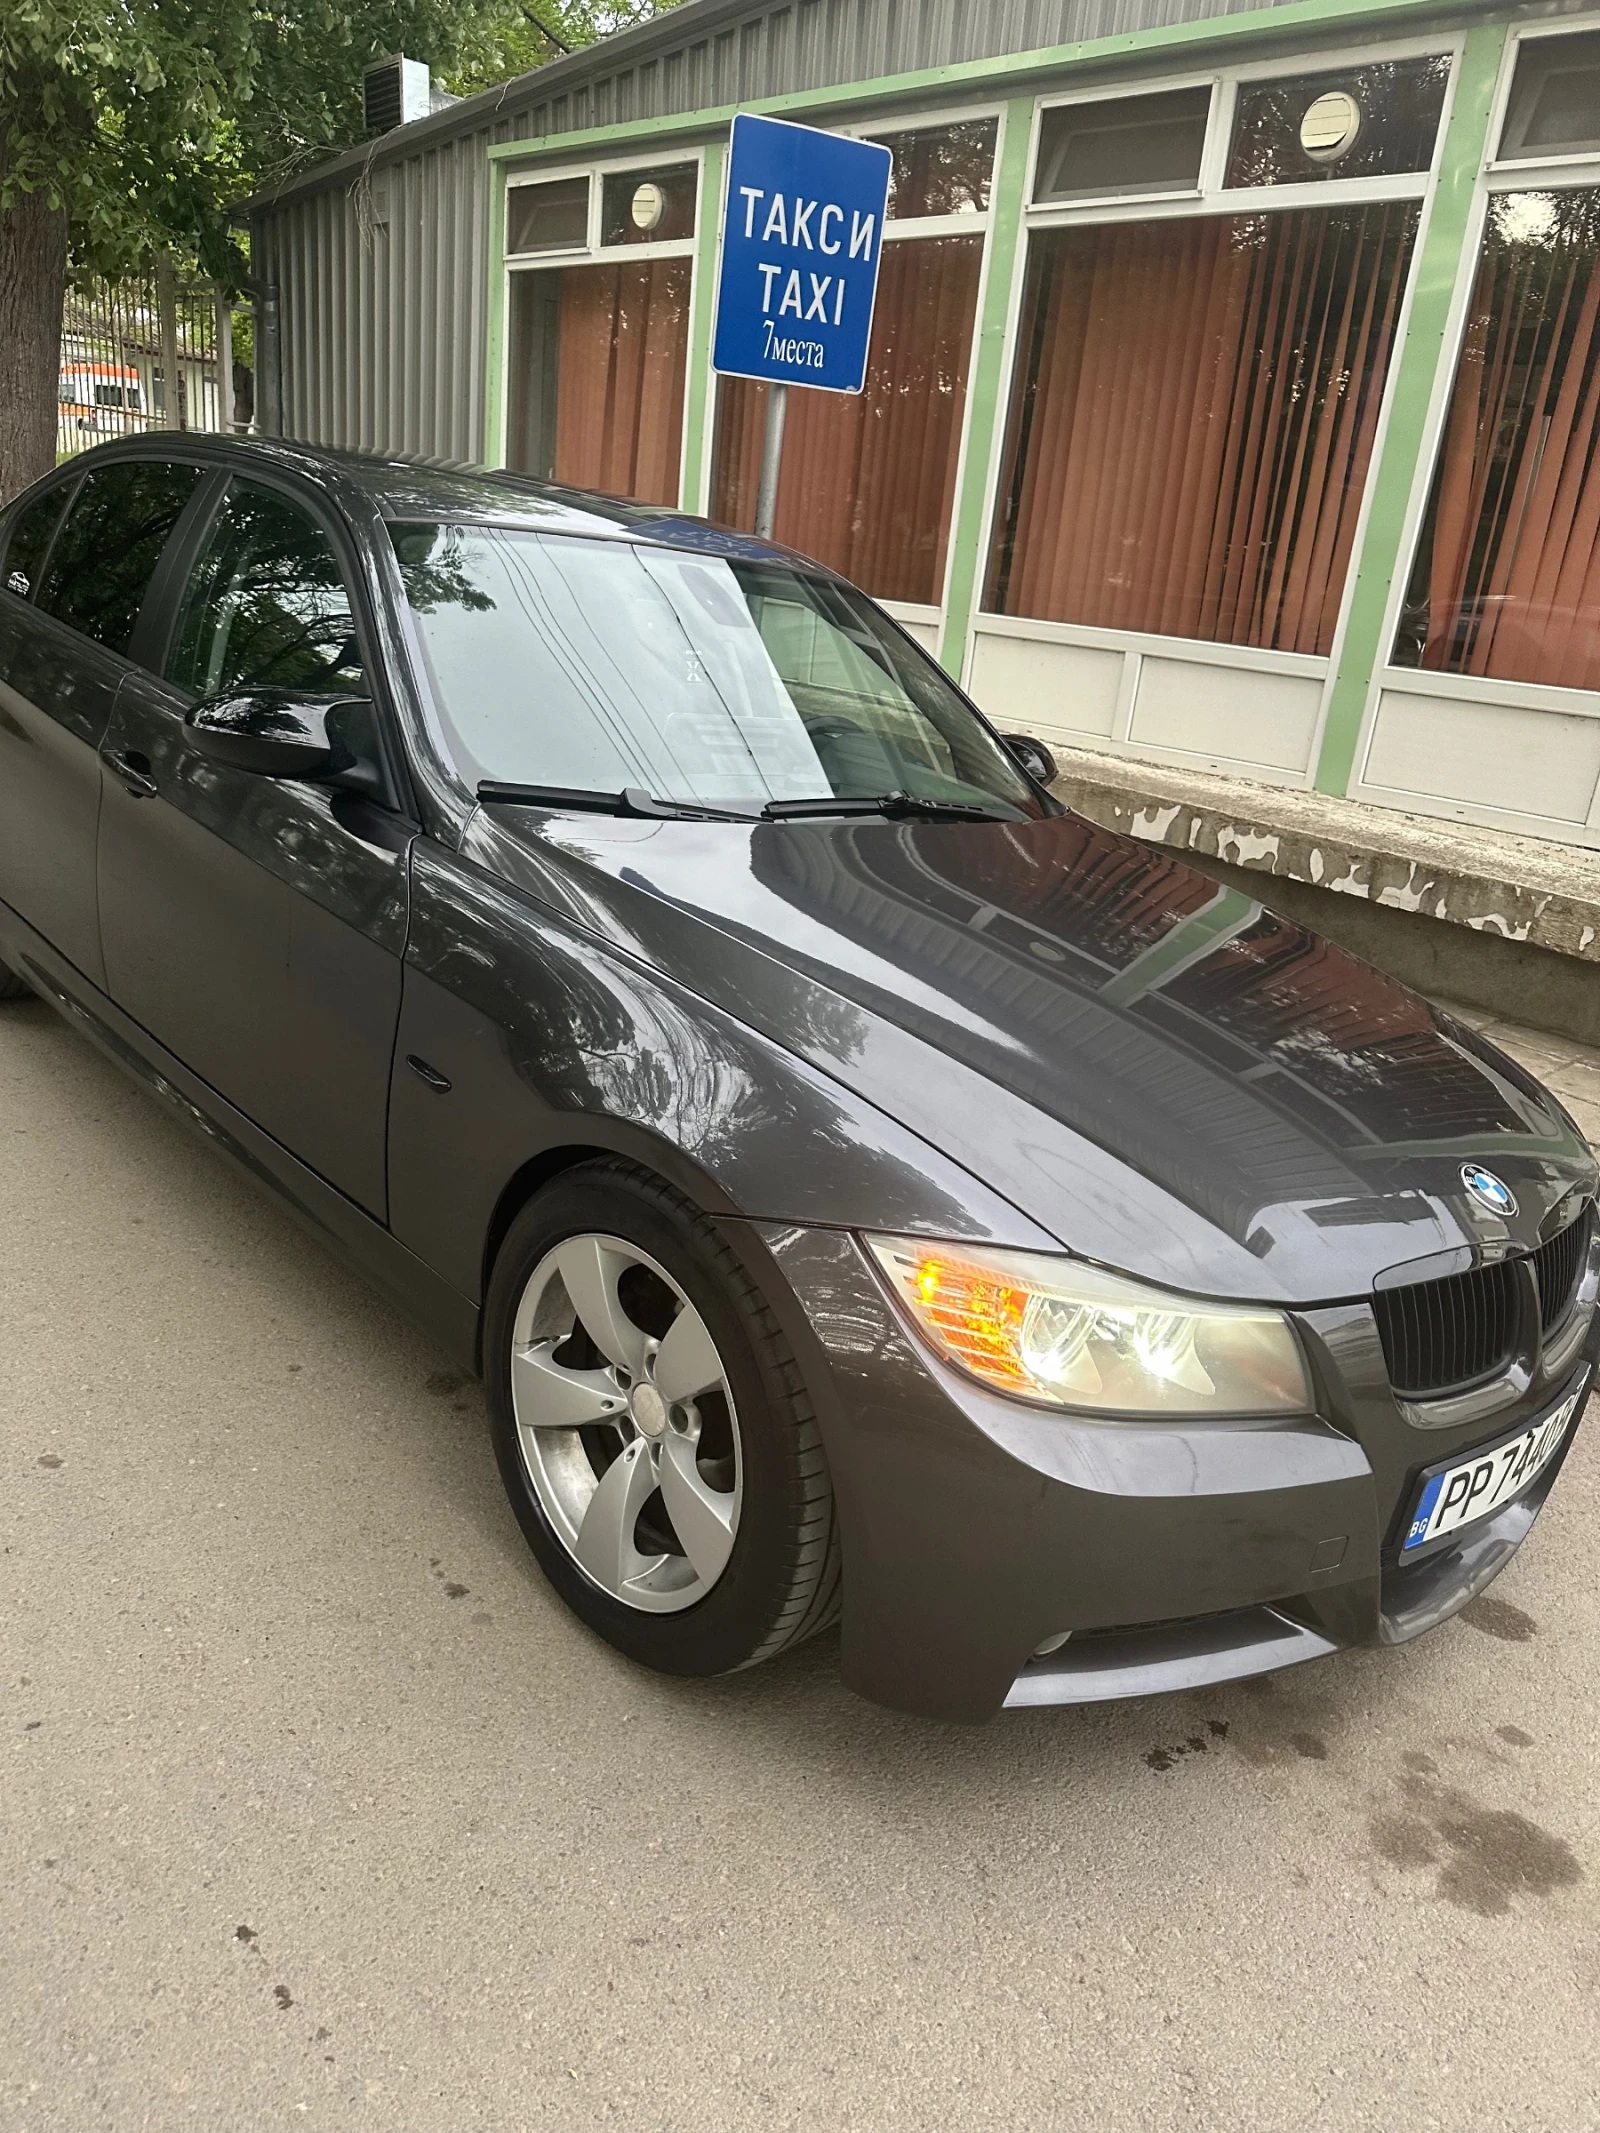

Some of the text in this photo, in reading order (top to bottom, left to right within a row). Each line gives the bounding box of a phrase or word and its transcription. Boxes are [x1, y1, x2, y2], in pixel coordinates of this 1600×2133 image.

[739, 186, 875, 262] ТАКСИ
[758, 263, 845, 326] TAXI
[1409, 1517, 1429, 1538] BG
